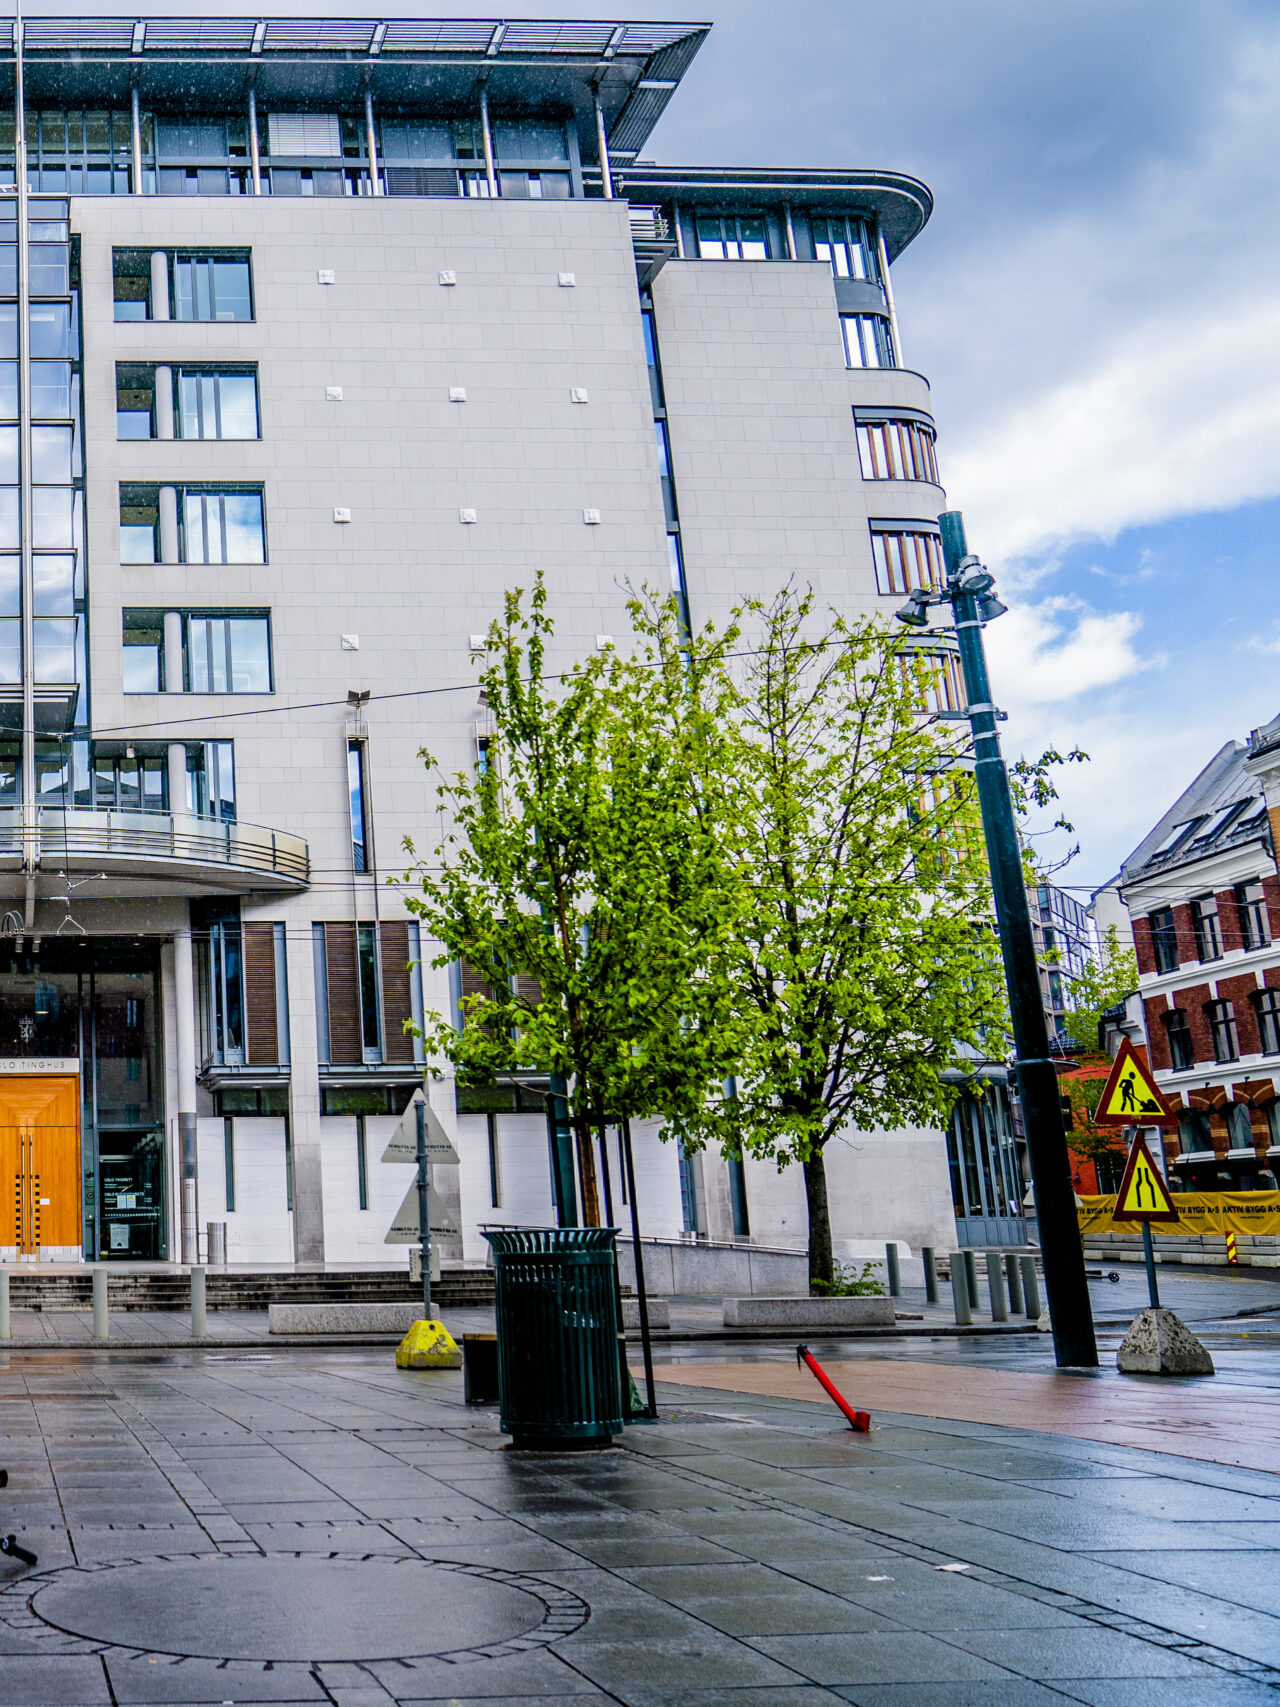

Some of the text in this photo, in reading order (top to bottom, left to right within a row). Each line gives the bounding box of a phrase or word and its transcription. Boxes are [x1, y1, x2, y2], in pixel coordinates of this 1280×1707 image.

[21, 1061, 65, 1069] TINGHUS
[1188, 1206, 1206, 1214] BYGG
[1222, 1205, 1244, 1213] AKTIV
[1245, 1205, 1267, 1213] BYGG
